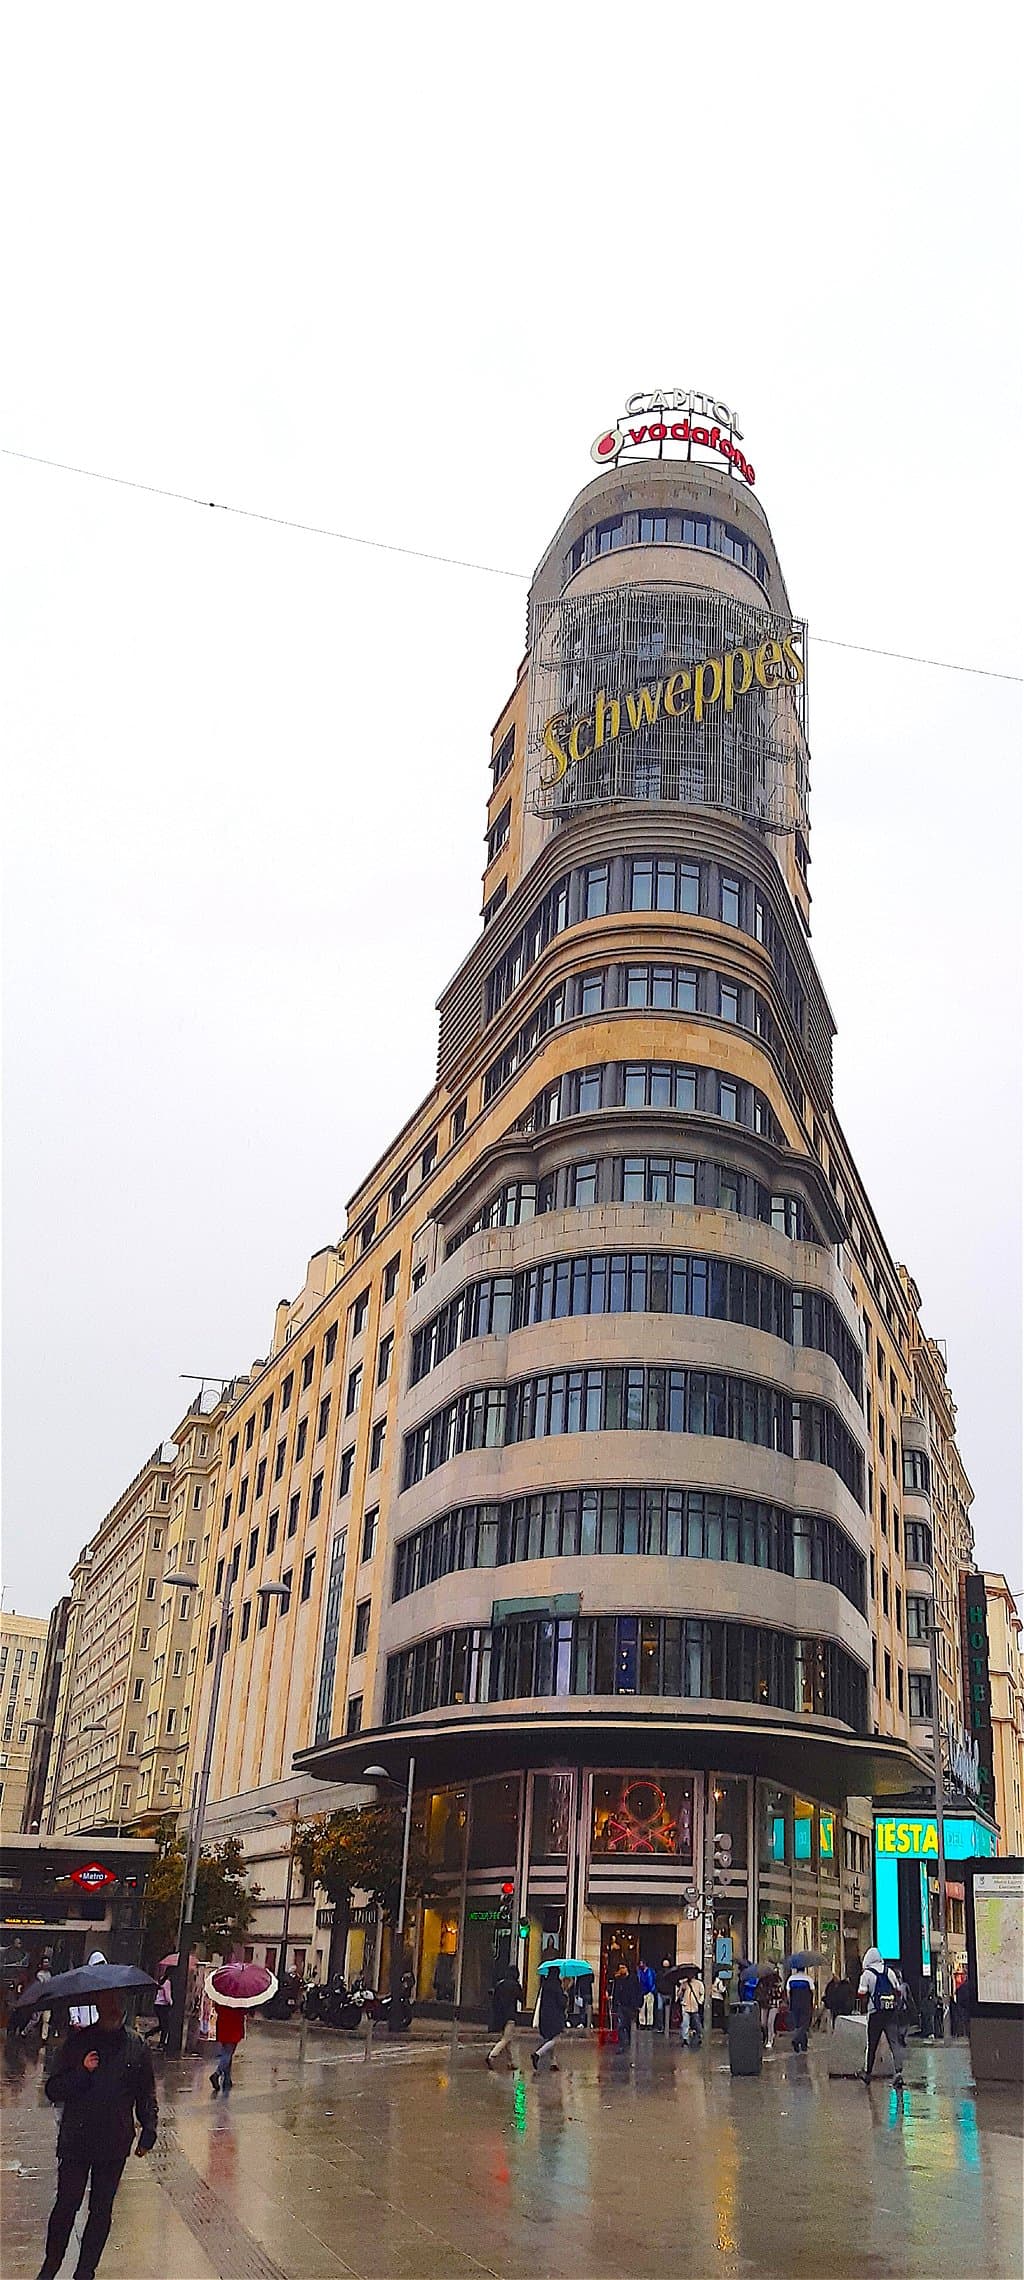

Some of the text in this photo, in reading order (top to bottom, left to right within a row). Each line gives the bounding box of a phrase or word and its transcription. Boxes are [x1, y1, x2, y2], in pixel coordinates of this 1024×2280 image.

[625, 388, 744, 440] CAPITOL
[628, 419, 756, 485] vodafone
[540, 632, 805, 790] Schweppes
[970, 1605, 985, 1729] HOTEL
[82, 1872, 104, 1880] Metro
